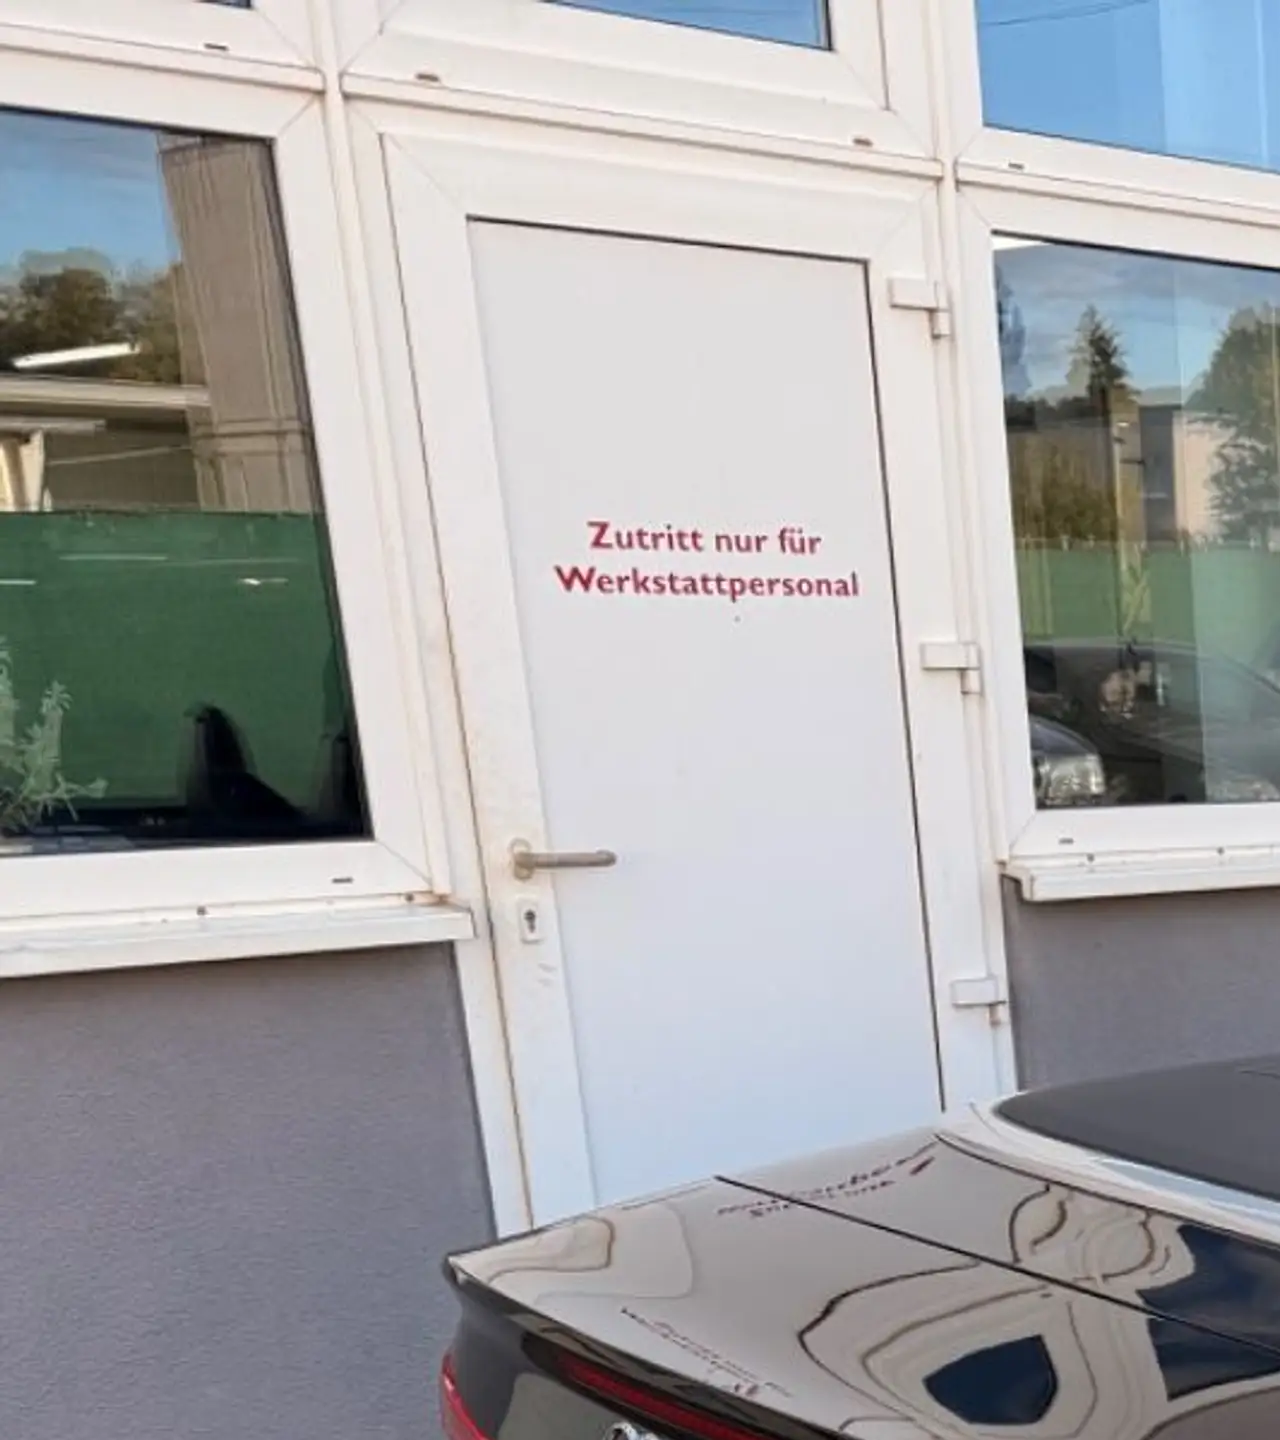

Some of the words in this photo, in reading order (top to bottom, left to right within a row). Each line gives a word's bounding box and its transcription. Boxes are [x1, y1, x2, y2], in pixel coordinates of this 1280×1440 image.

[587, 520, 703, 551] Zutritt
[714, 532, 768, 553] nur
[778, 527, 822, 554] für
[554, 563, 860, 602] Werkstattpersonal
